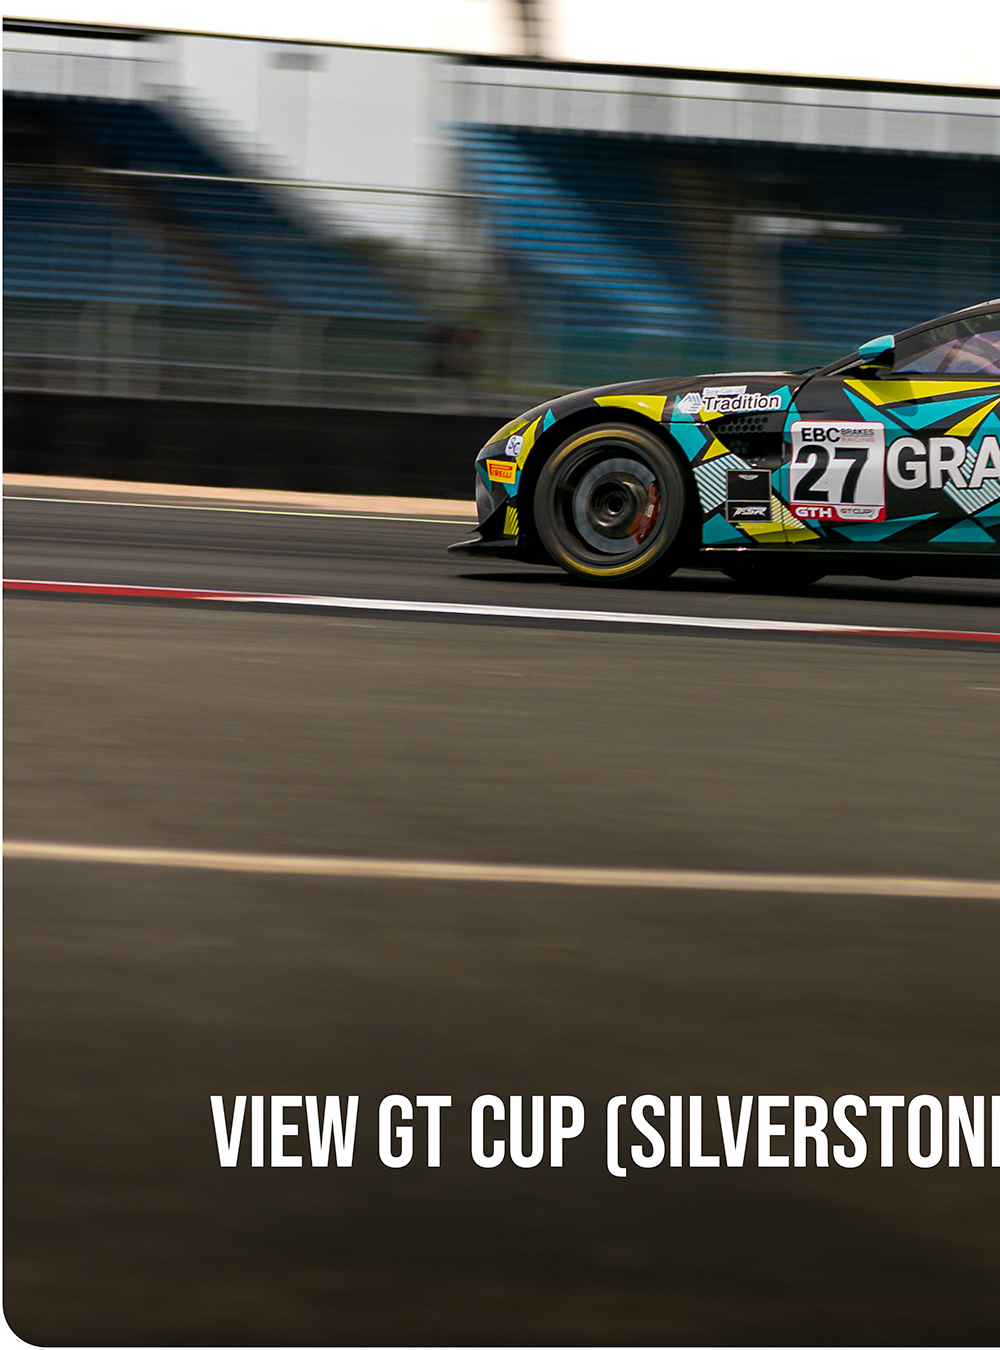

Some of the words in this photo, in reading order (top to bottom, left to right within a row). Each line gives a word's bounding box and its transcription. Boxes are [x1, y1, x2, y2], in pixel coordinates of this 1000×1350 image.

[704, 394, 779, 411] Tradition
[801, 428, 840, 442] EBC
[793, 445, 869, 503] 27
[795, 507, 832, 518] GTH
